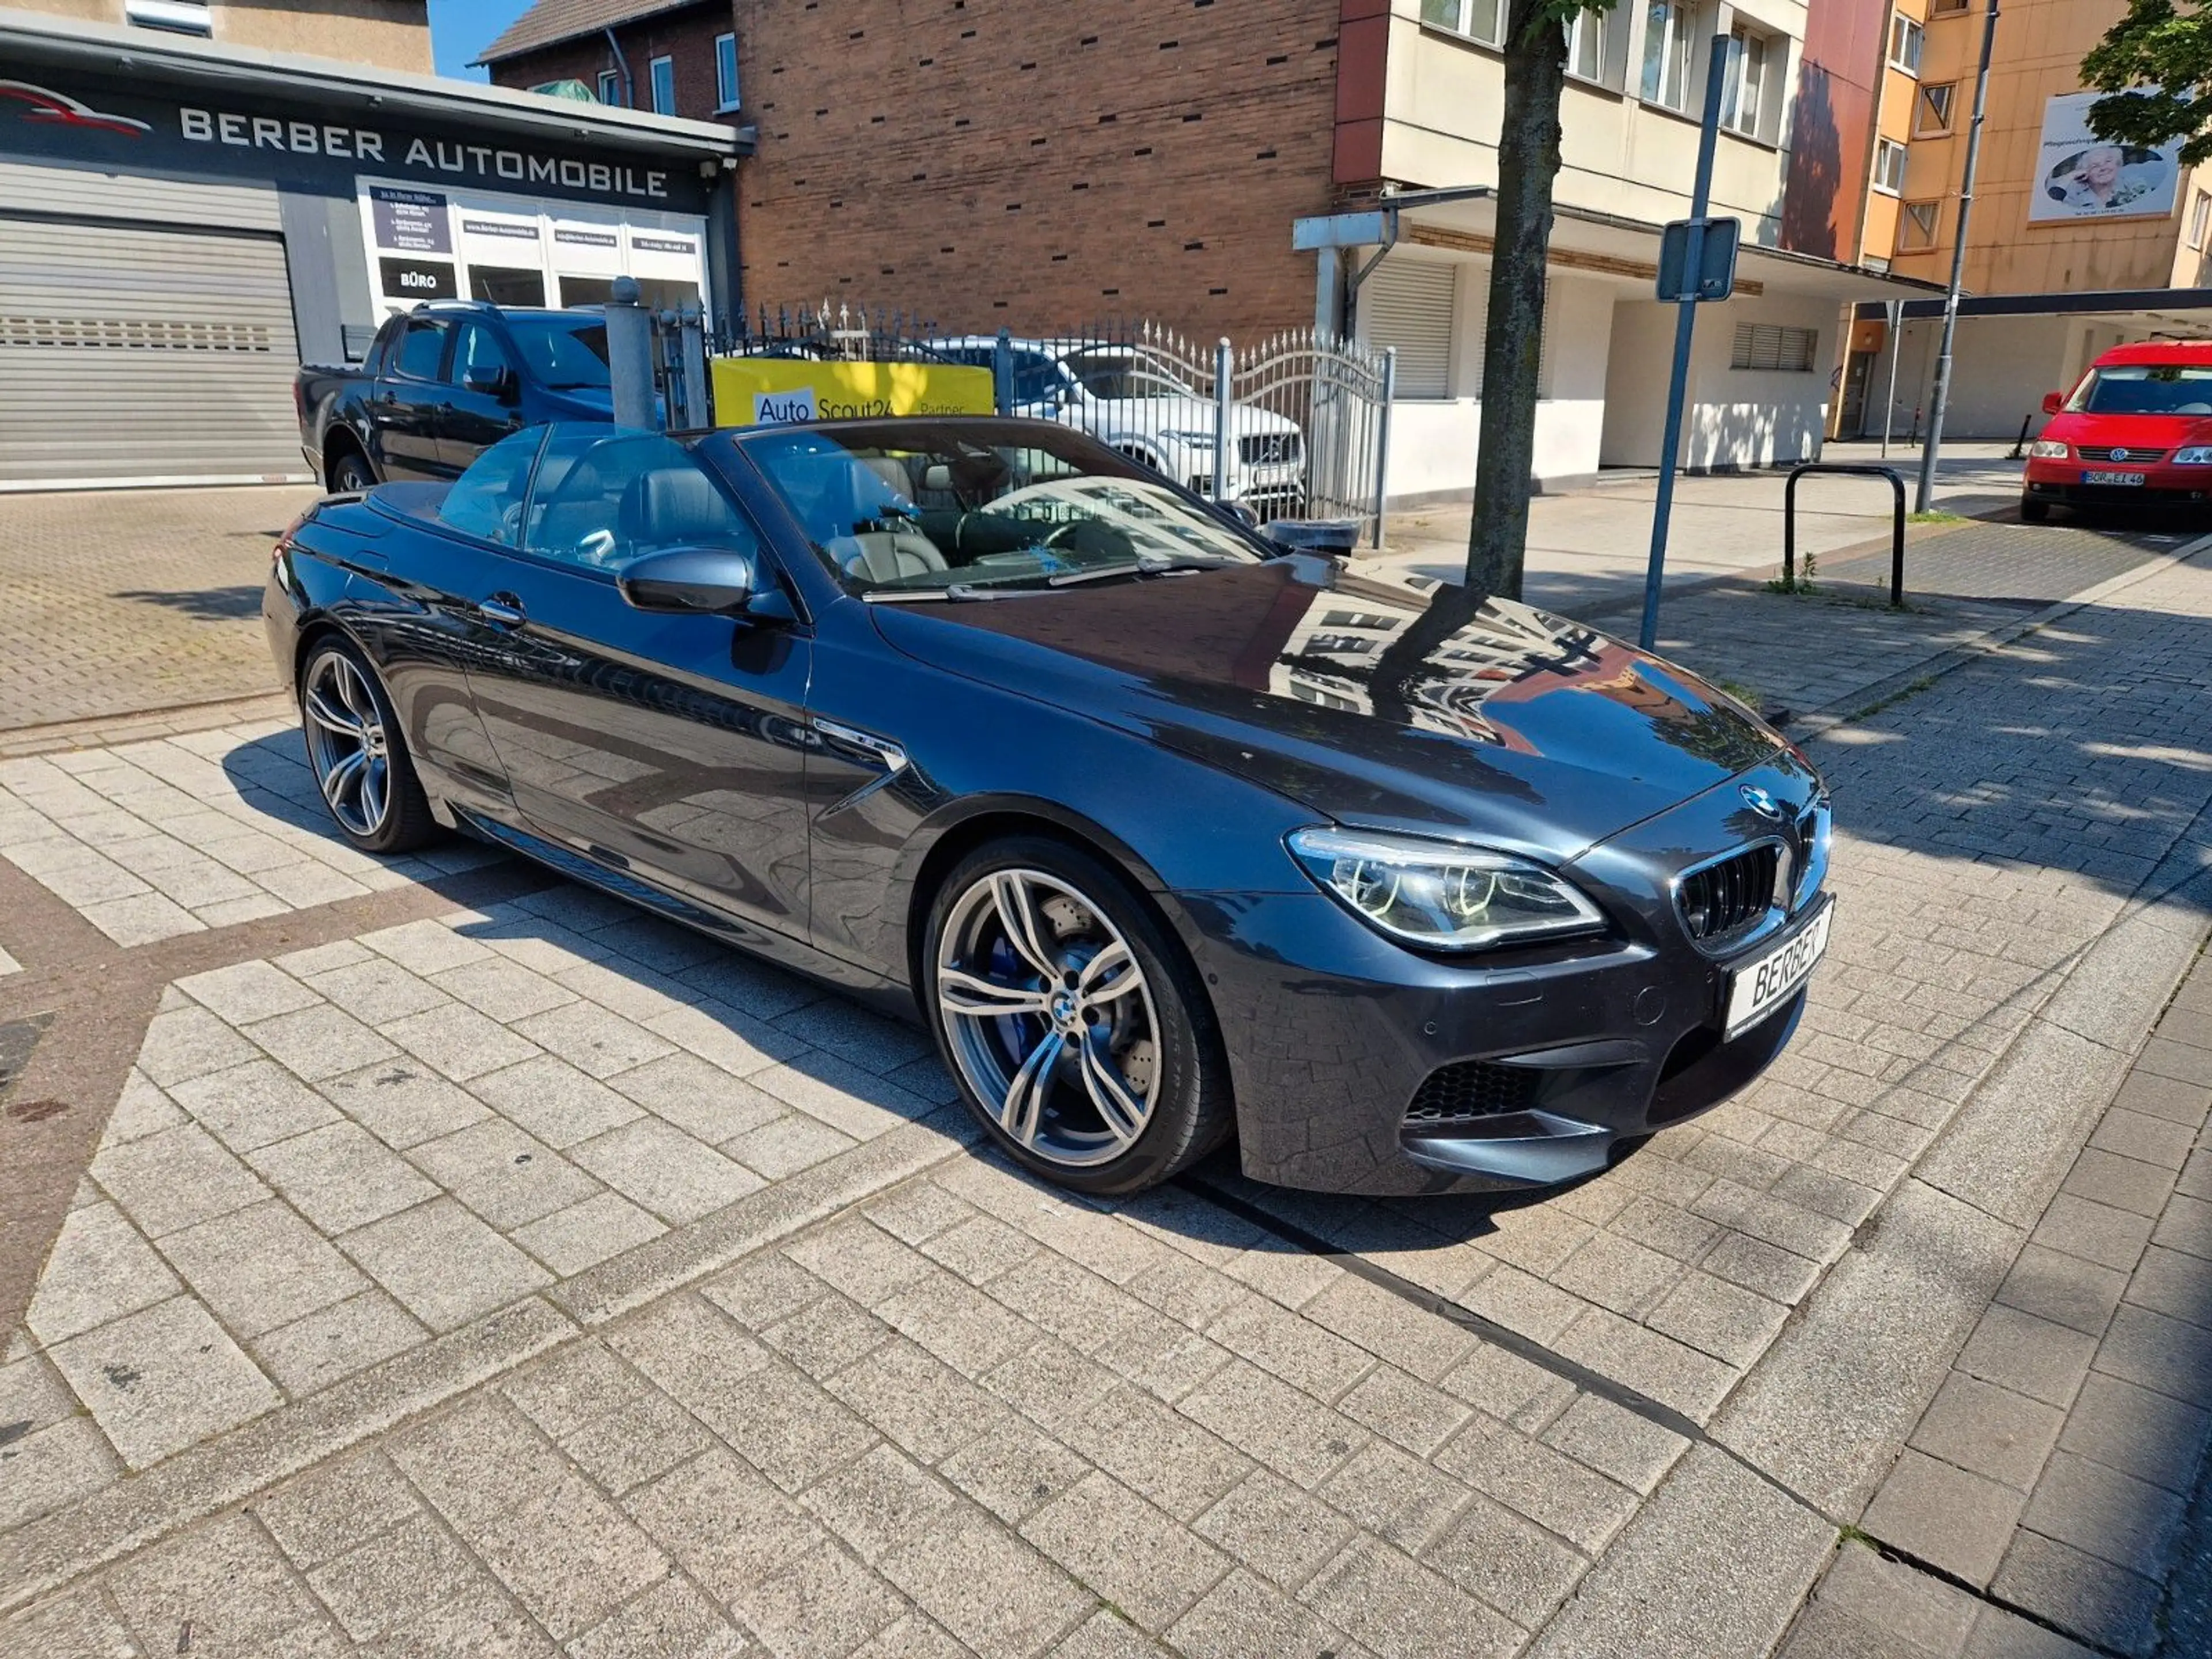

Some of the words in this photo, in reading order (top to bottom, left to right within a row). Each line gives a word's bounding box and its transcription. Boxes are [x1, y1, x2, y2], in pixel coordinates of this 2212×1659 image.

[180, 108, 385, 162] BERBER
[404, 138, 668, 197] AUTOMOBILE
[401, 271, 437, 288] BÜRO
[760, 397, 809, 422] Auto
[819, 399, 894, 421] Scout24
[921, 402, 965, 417] Partner
